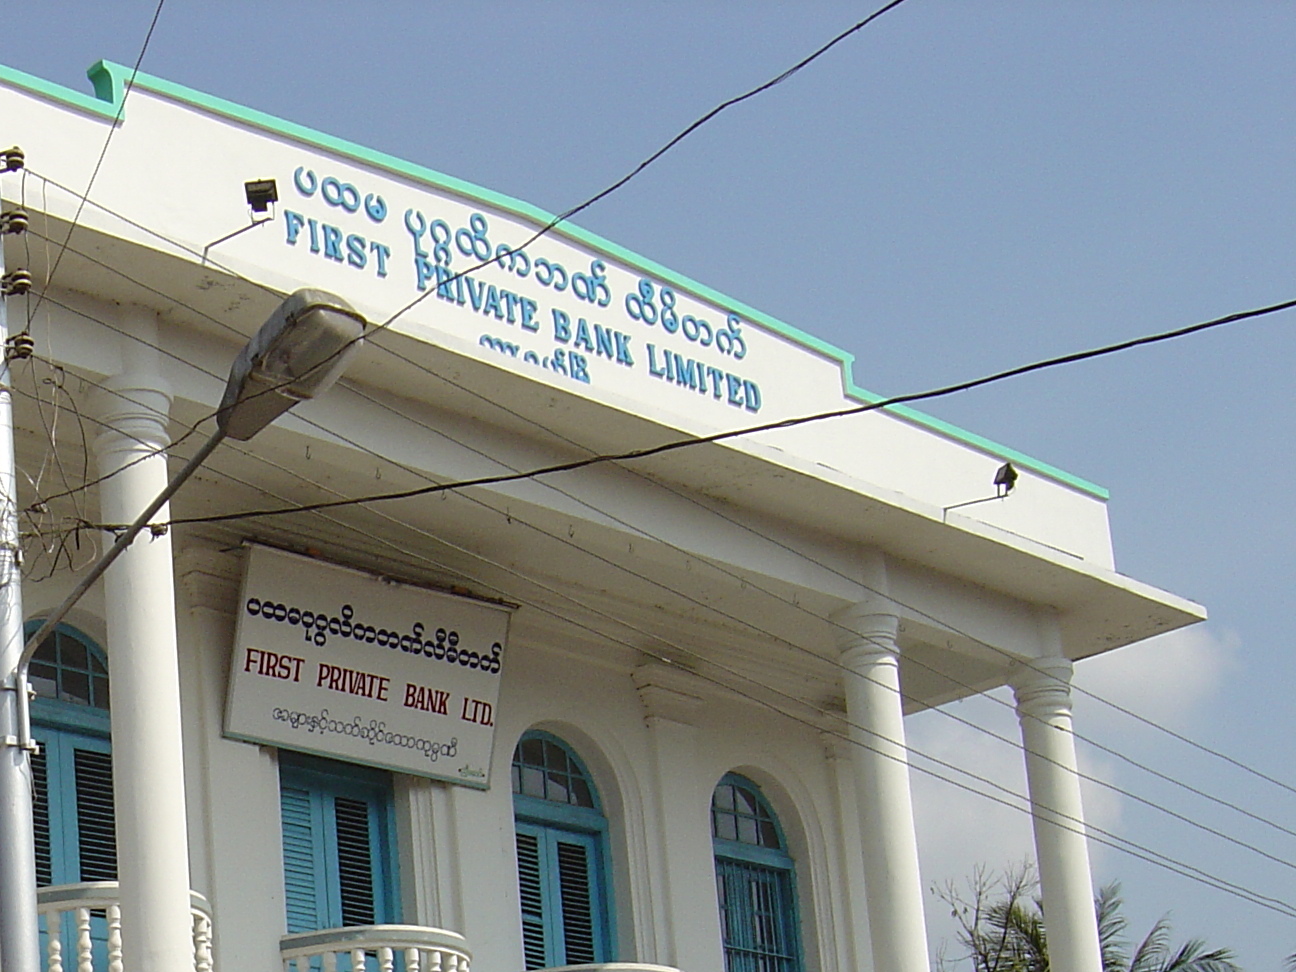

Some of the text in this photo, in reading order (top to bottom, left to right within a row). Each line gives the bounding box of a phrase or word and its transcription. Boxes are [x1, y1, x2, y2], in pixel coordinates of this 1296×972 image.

[284, 210, 762, 412] FIRST PRIVATE BANK LIMITED
[244, 647, 494, 727] FIRST PRIVATE BANK LTD.
